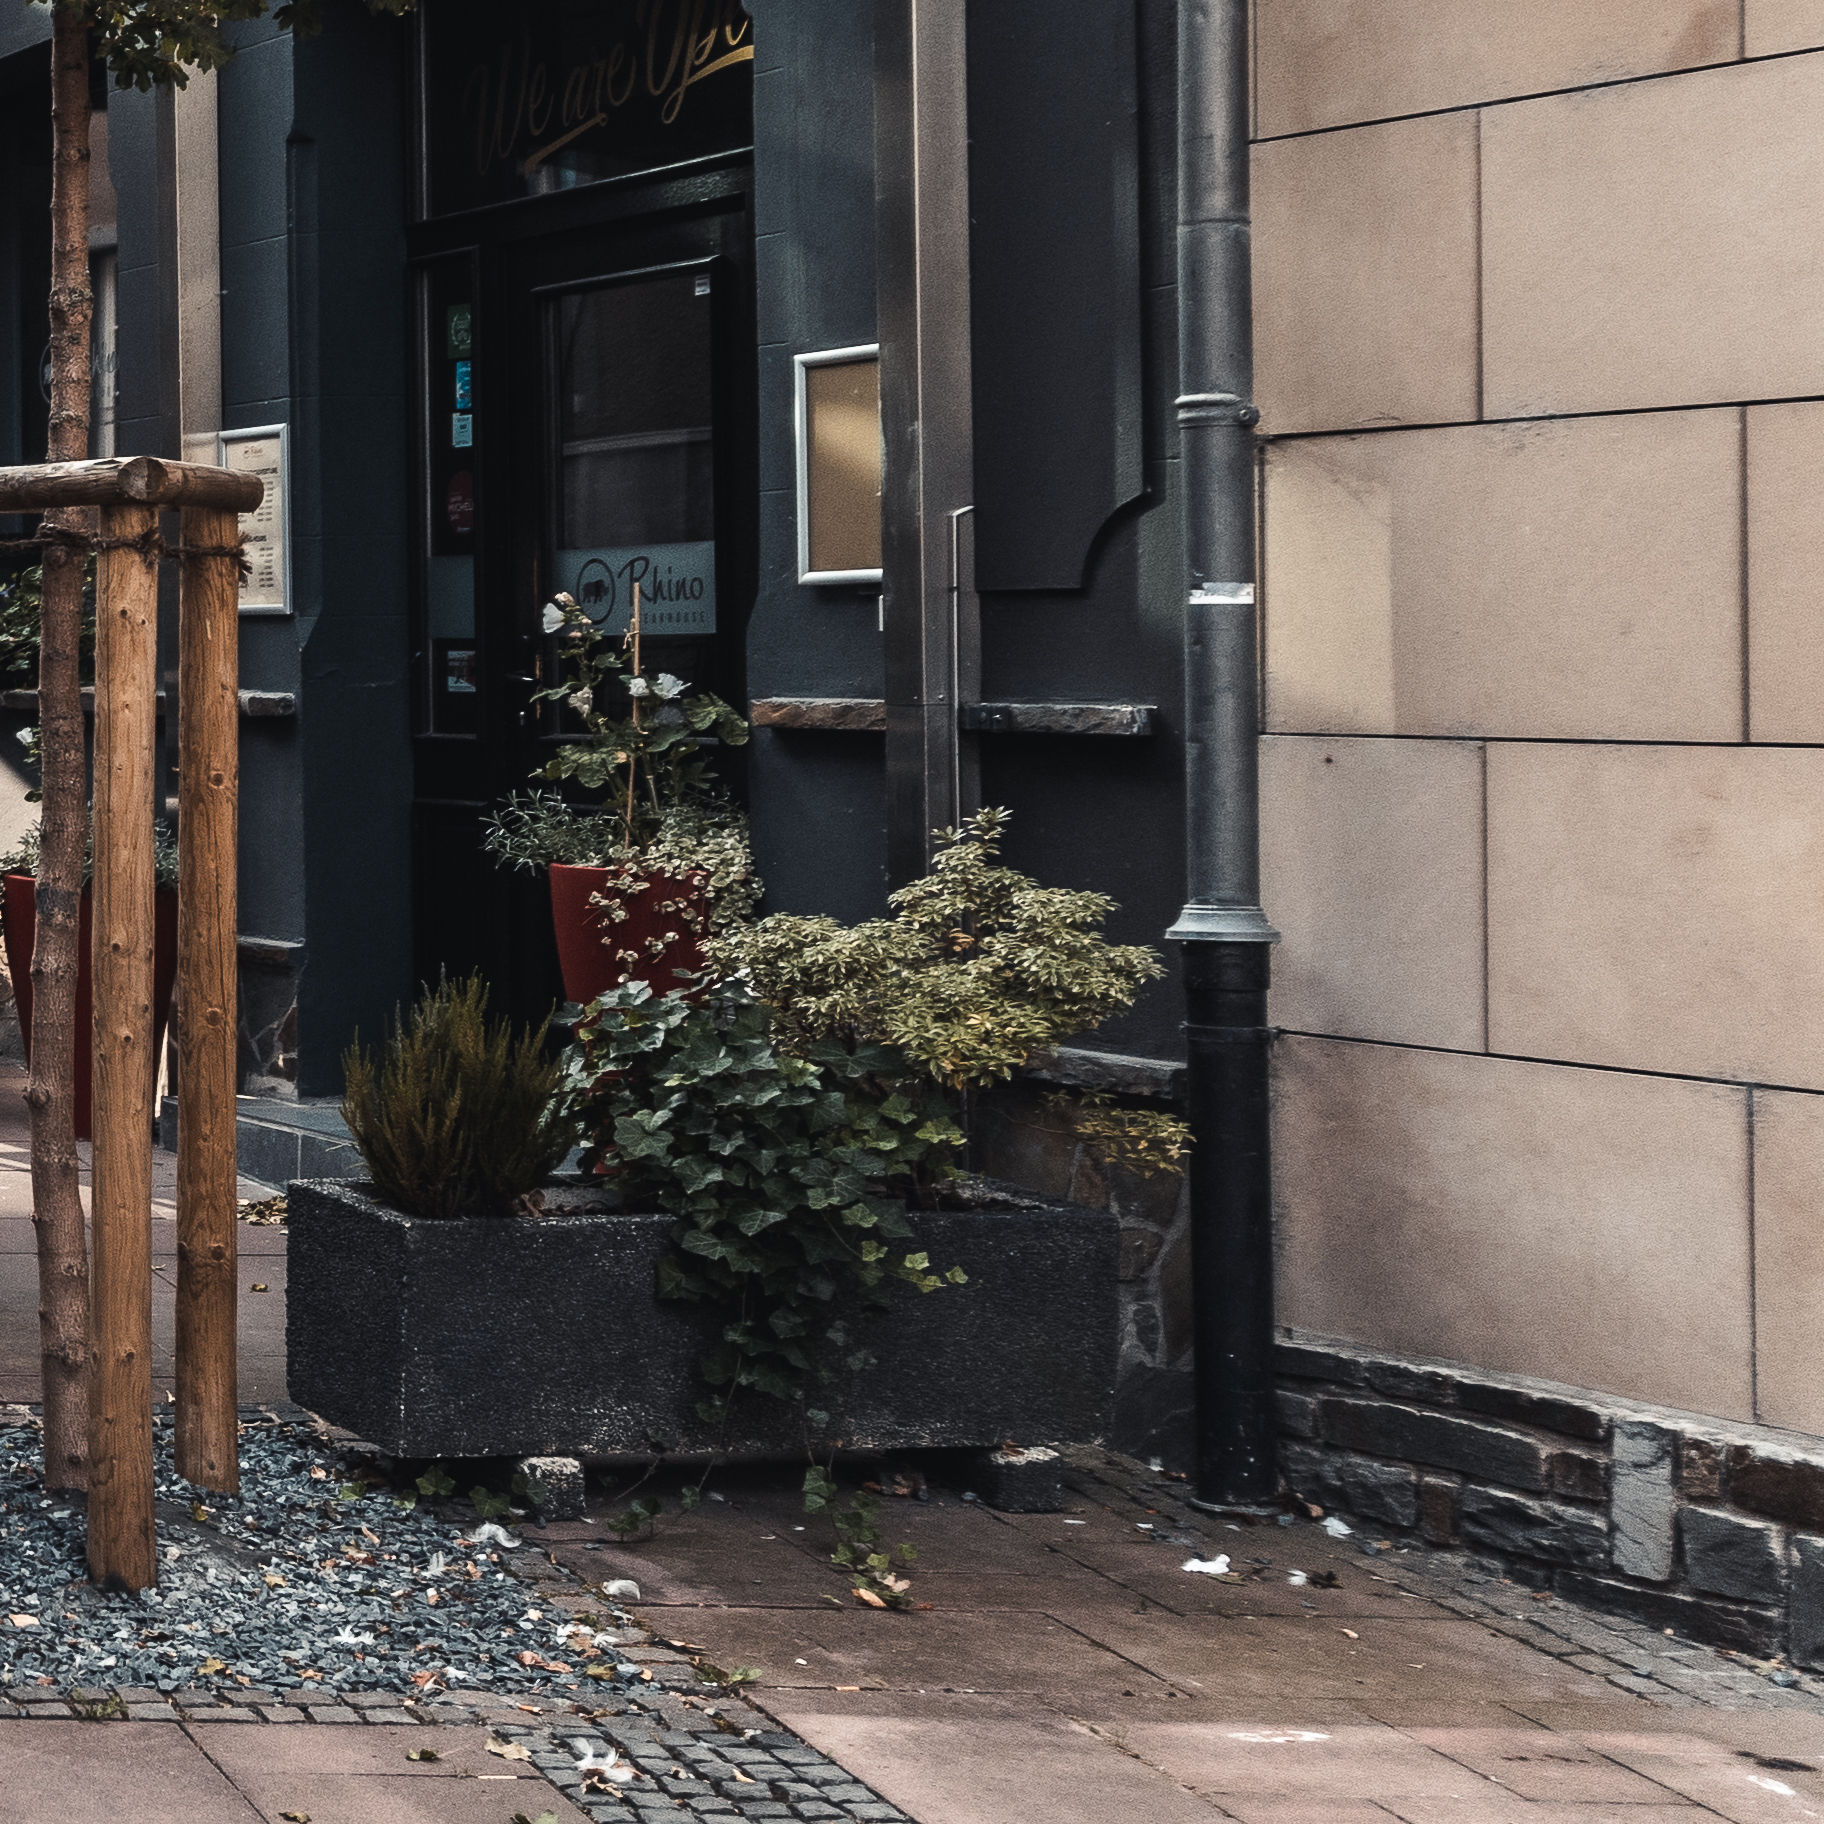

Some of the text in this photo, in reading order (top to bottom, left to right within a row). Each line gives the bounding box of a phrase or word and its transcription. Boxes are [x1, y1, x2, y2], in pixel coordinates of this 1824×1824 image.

[462, 21, 555, 176] We
[563, 42, 637, 127] are
[617, 555, 704, 608] Rhino
